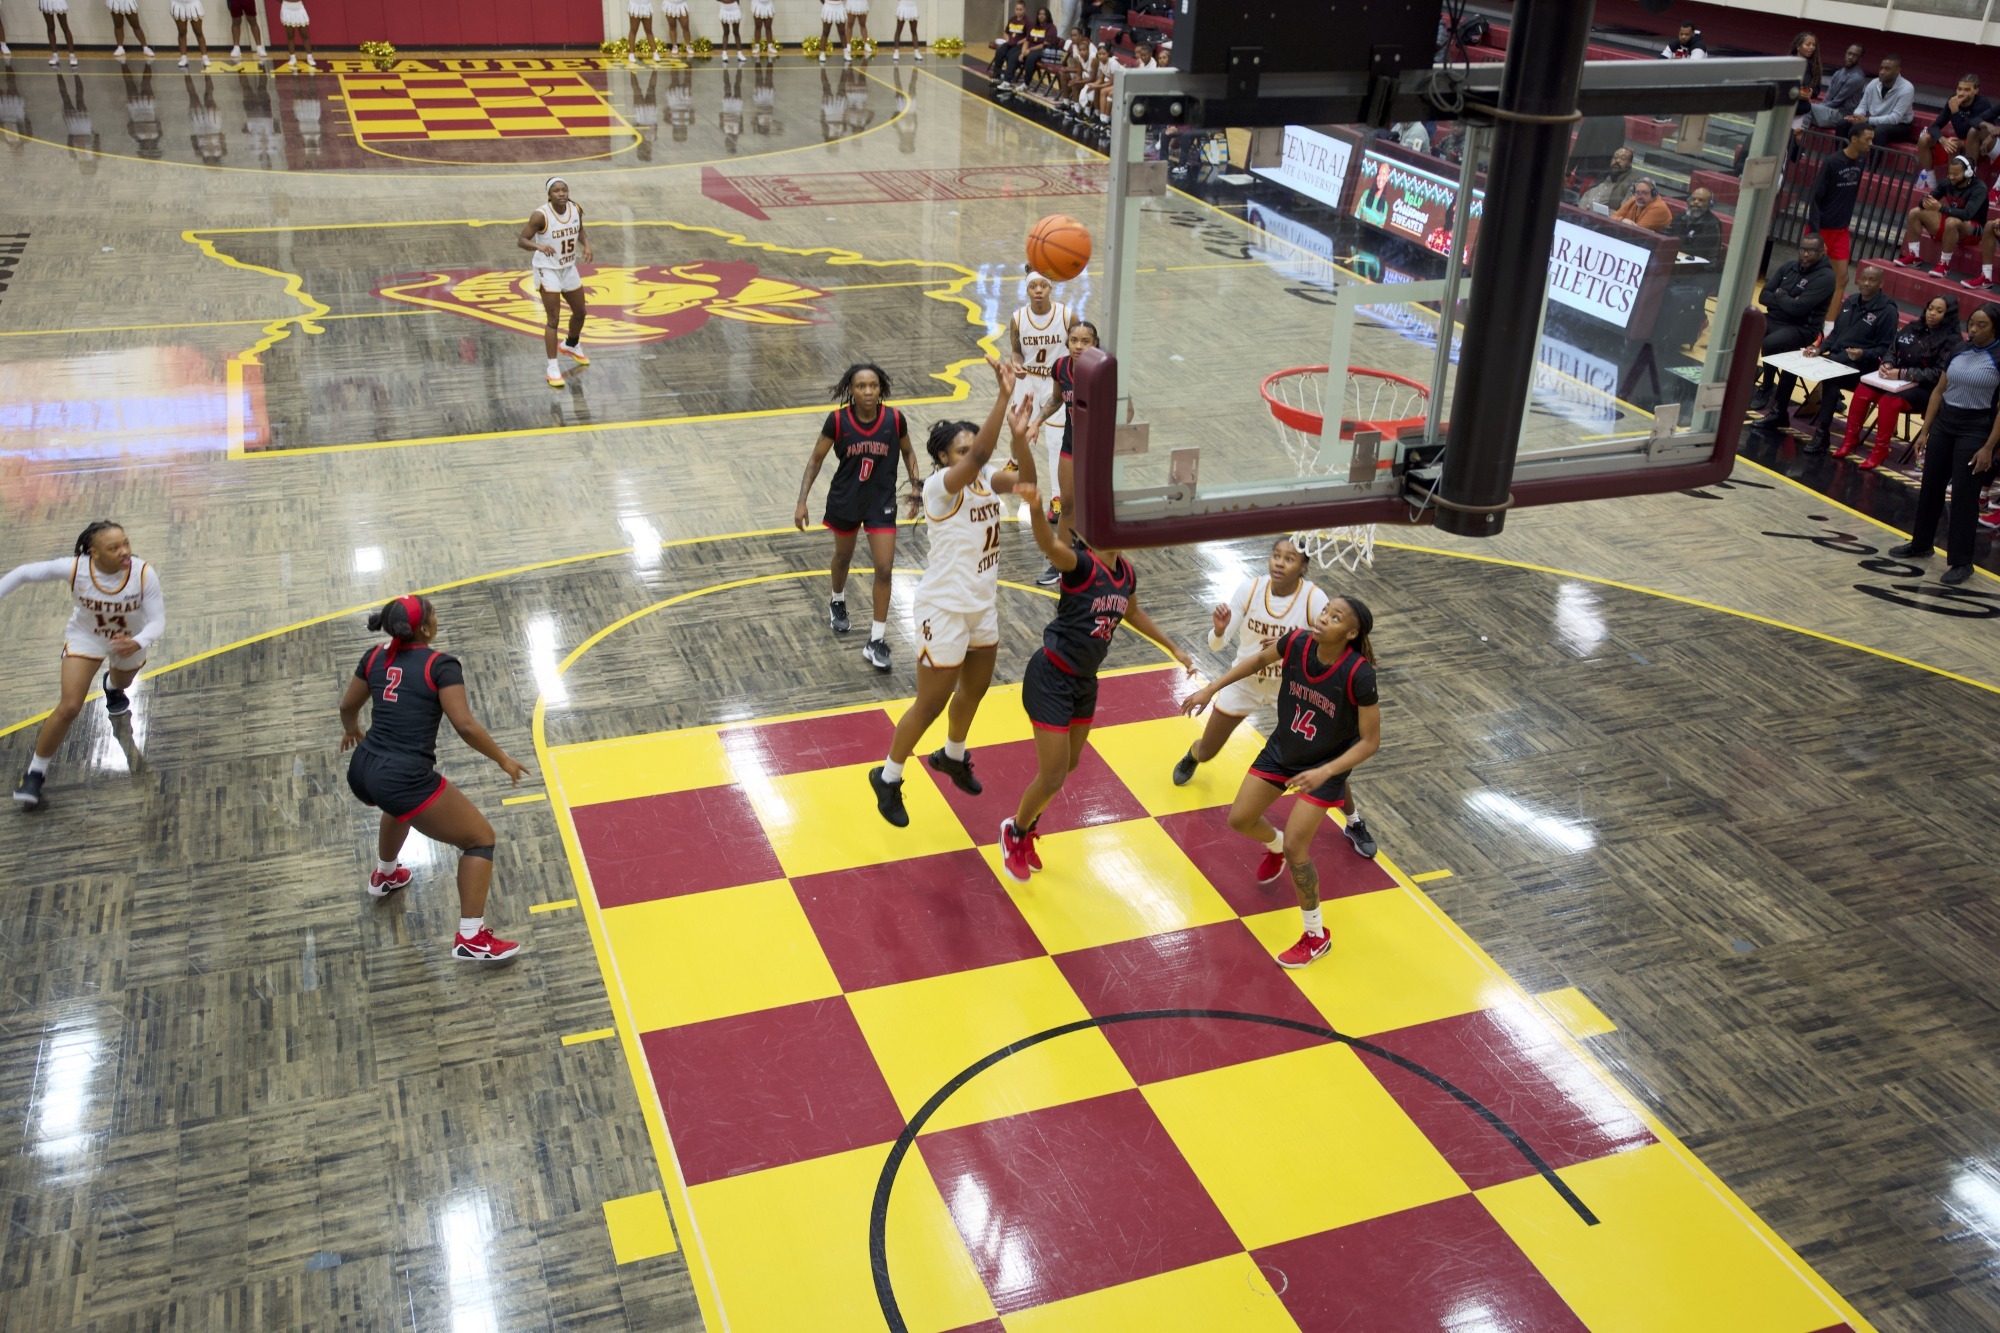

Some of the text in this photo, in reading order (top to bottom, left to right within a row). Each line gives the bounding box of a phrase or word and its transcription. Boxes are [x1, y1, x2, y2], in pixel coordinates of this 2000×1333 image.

[201, 58, 689, 73] MARAUDERS
[1404, 192, 1424, 209] UGLY
[1391, 212, 1424, 234] SWEATER
[561, 238, 575, 255] 15
[1549, 237, 1643, 289] RAUDER
[1547, 261, 1633, 313] HLETICS
[1022, 335, 1062, 346] CENTRAL
[1036, 348, 1047, 363] 0
[847, 441, 889, 458] PANTHERS
[859, 457, 874, 482] 0
[970, 503, 1000, 523] CENTR
[978, 551, 1000, 574] STATE
[79, 596, 141, 613] CENTRAL
[1248, 618, 1298, 636] CENTR
[382, 666, 403, 702] 2
[1289, 680, 1336, 719] PANTHERS
[1290, 703, 1317, 742] 14
